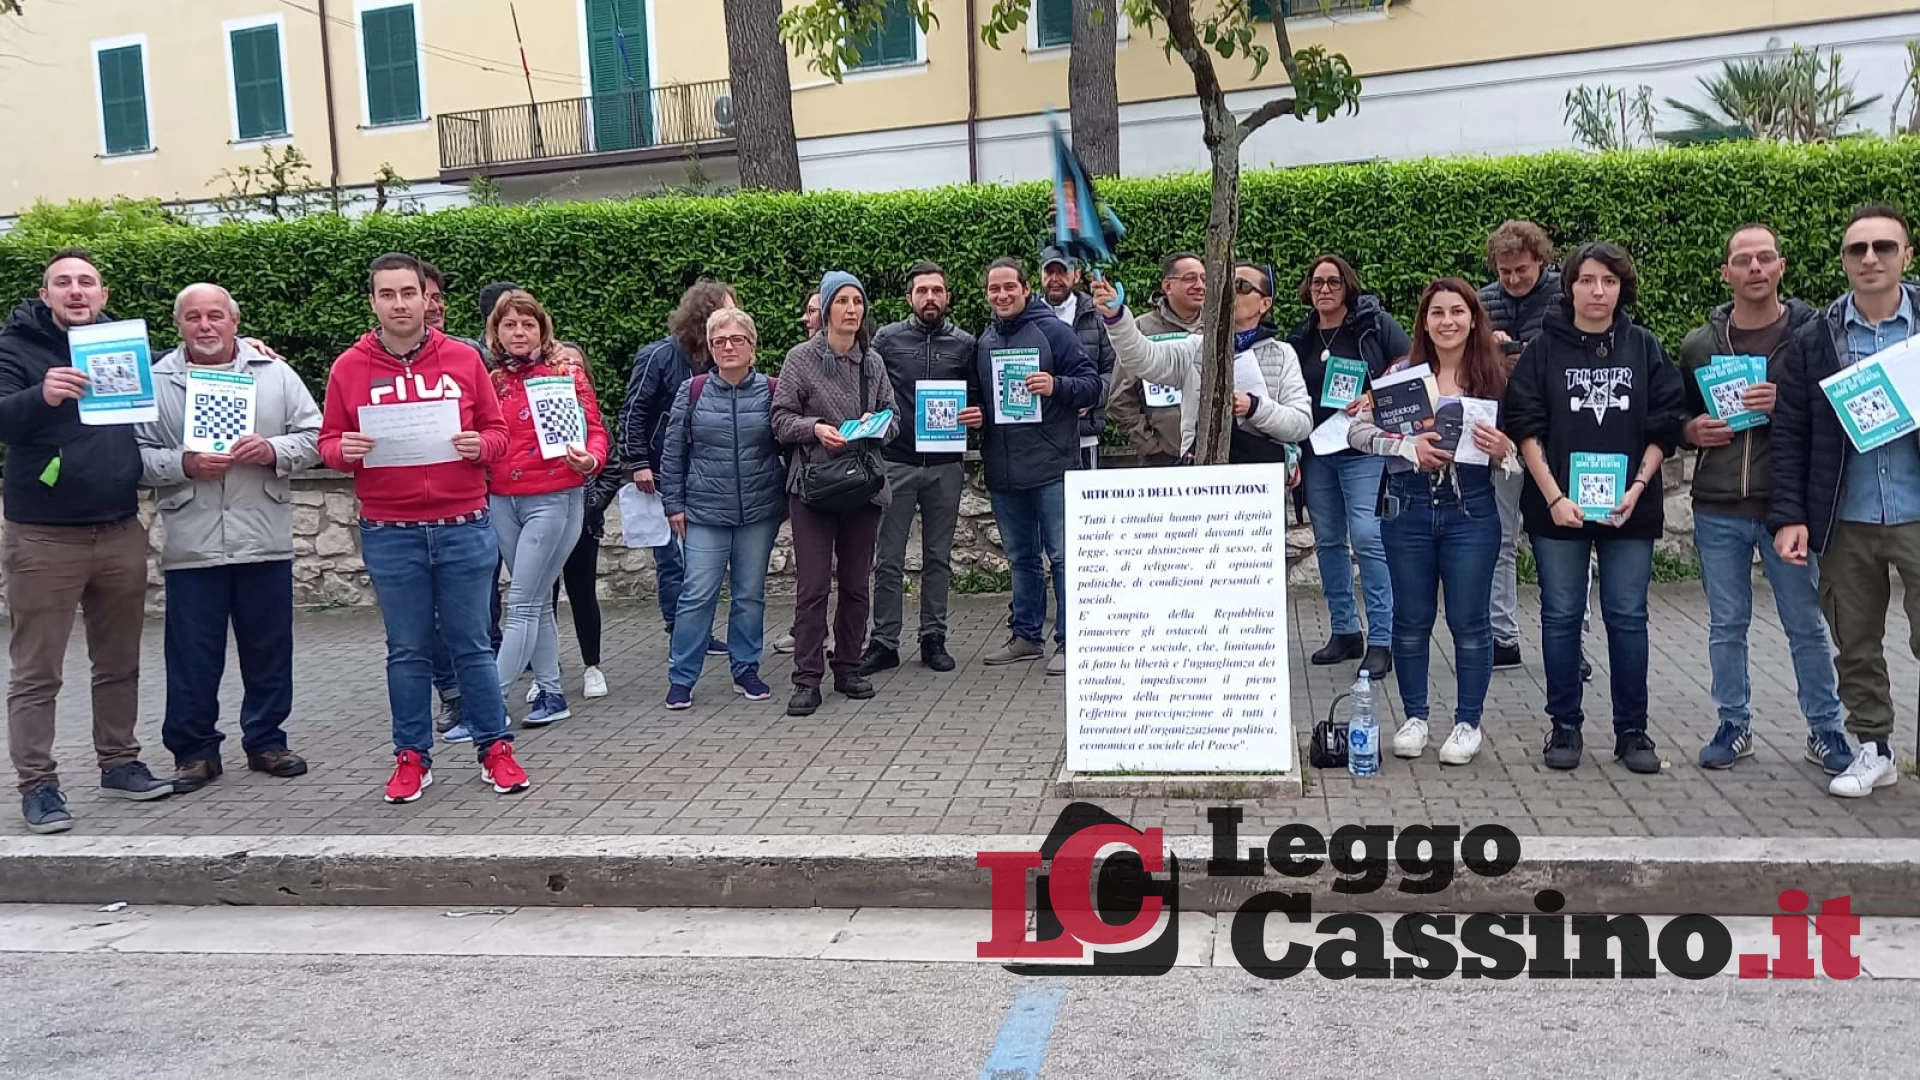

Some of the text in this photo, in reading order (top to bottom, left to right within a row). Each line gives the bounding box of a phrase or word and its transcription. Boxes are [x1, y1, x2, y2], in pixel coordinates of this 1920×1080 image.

[370, 374, 462, 404] FILA
[1082, 484, 1269, 499] ARTICOLO 3 DELLA COSTITUZIONE
[1121, 514, 1163, 523] cittadini
[1170, 513, 1201, 522] hanno
[1207, 514, 1228, 523] pari
[1235, 510, 1271, 521] dignità
[1078, 531, 1113, 540] sociale
[1165, 528, 1197, 540] uguali
[1205, 528, 1243, 537] davanti
[1251, 526, 1272, 536] alla
[1115, 548, 1142, 556] senza
[1148, 545, 1204, 555] distinzione
[1209, 544, 1219, 553] di
[1262, 543, 1272, 552] di
[1121, 562, 1130, 571] di
[1206, 560, 1215, 569] di
[1229, 561, 1272, 571] opinioni
[1133, 577, 1142, 587] di
[1149, 576, 1203, 587] condizioni
[1210, 575, 1260, 588] personali
[1108, 612, 1149, 622] compito
[1168, 609, 1194, 619] della
[1214, 608, 1274, 620] Repubblica
[1079, 624, 1274, 637] rimuovere gli ostacoli di ordine
[1079, 643, 1134, 653] economico
[1224, 641, 1275, 651] limitando
[1079, 660, 1088, 669] di
[1091, 660, 1116, 671] fatto
[1120, 659, 1130, 668] la
[1135, 658, 1169, 668] libertà
[1259, 657, 1275, 667] dei
[1141, 675, 1206, 687] impediscono
[1223, 674, 1230, 684] il
[1246, 677, 1276, 686] pieno
[1079, 692, 1122, 704] sviluppo
[1133, 691, 1158, 701] della
[1169, 694, 1212, 703] persona
[1135, 708, 1213, 720] partecipazione
[1222, 708, 1232, 717] di
[1080, 725, 1131, 734] lavoratori
[1149, 740, 1184, 750] sociale
[1188, 740, 1204, 750] del
